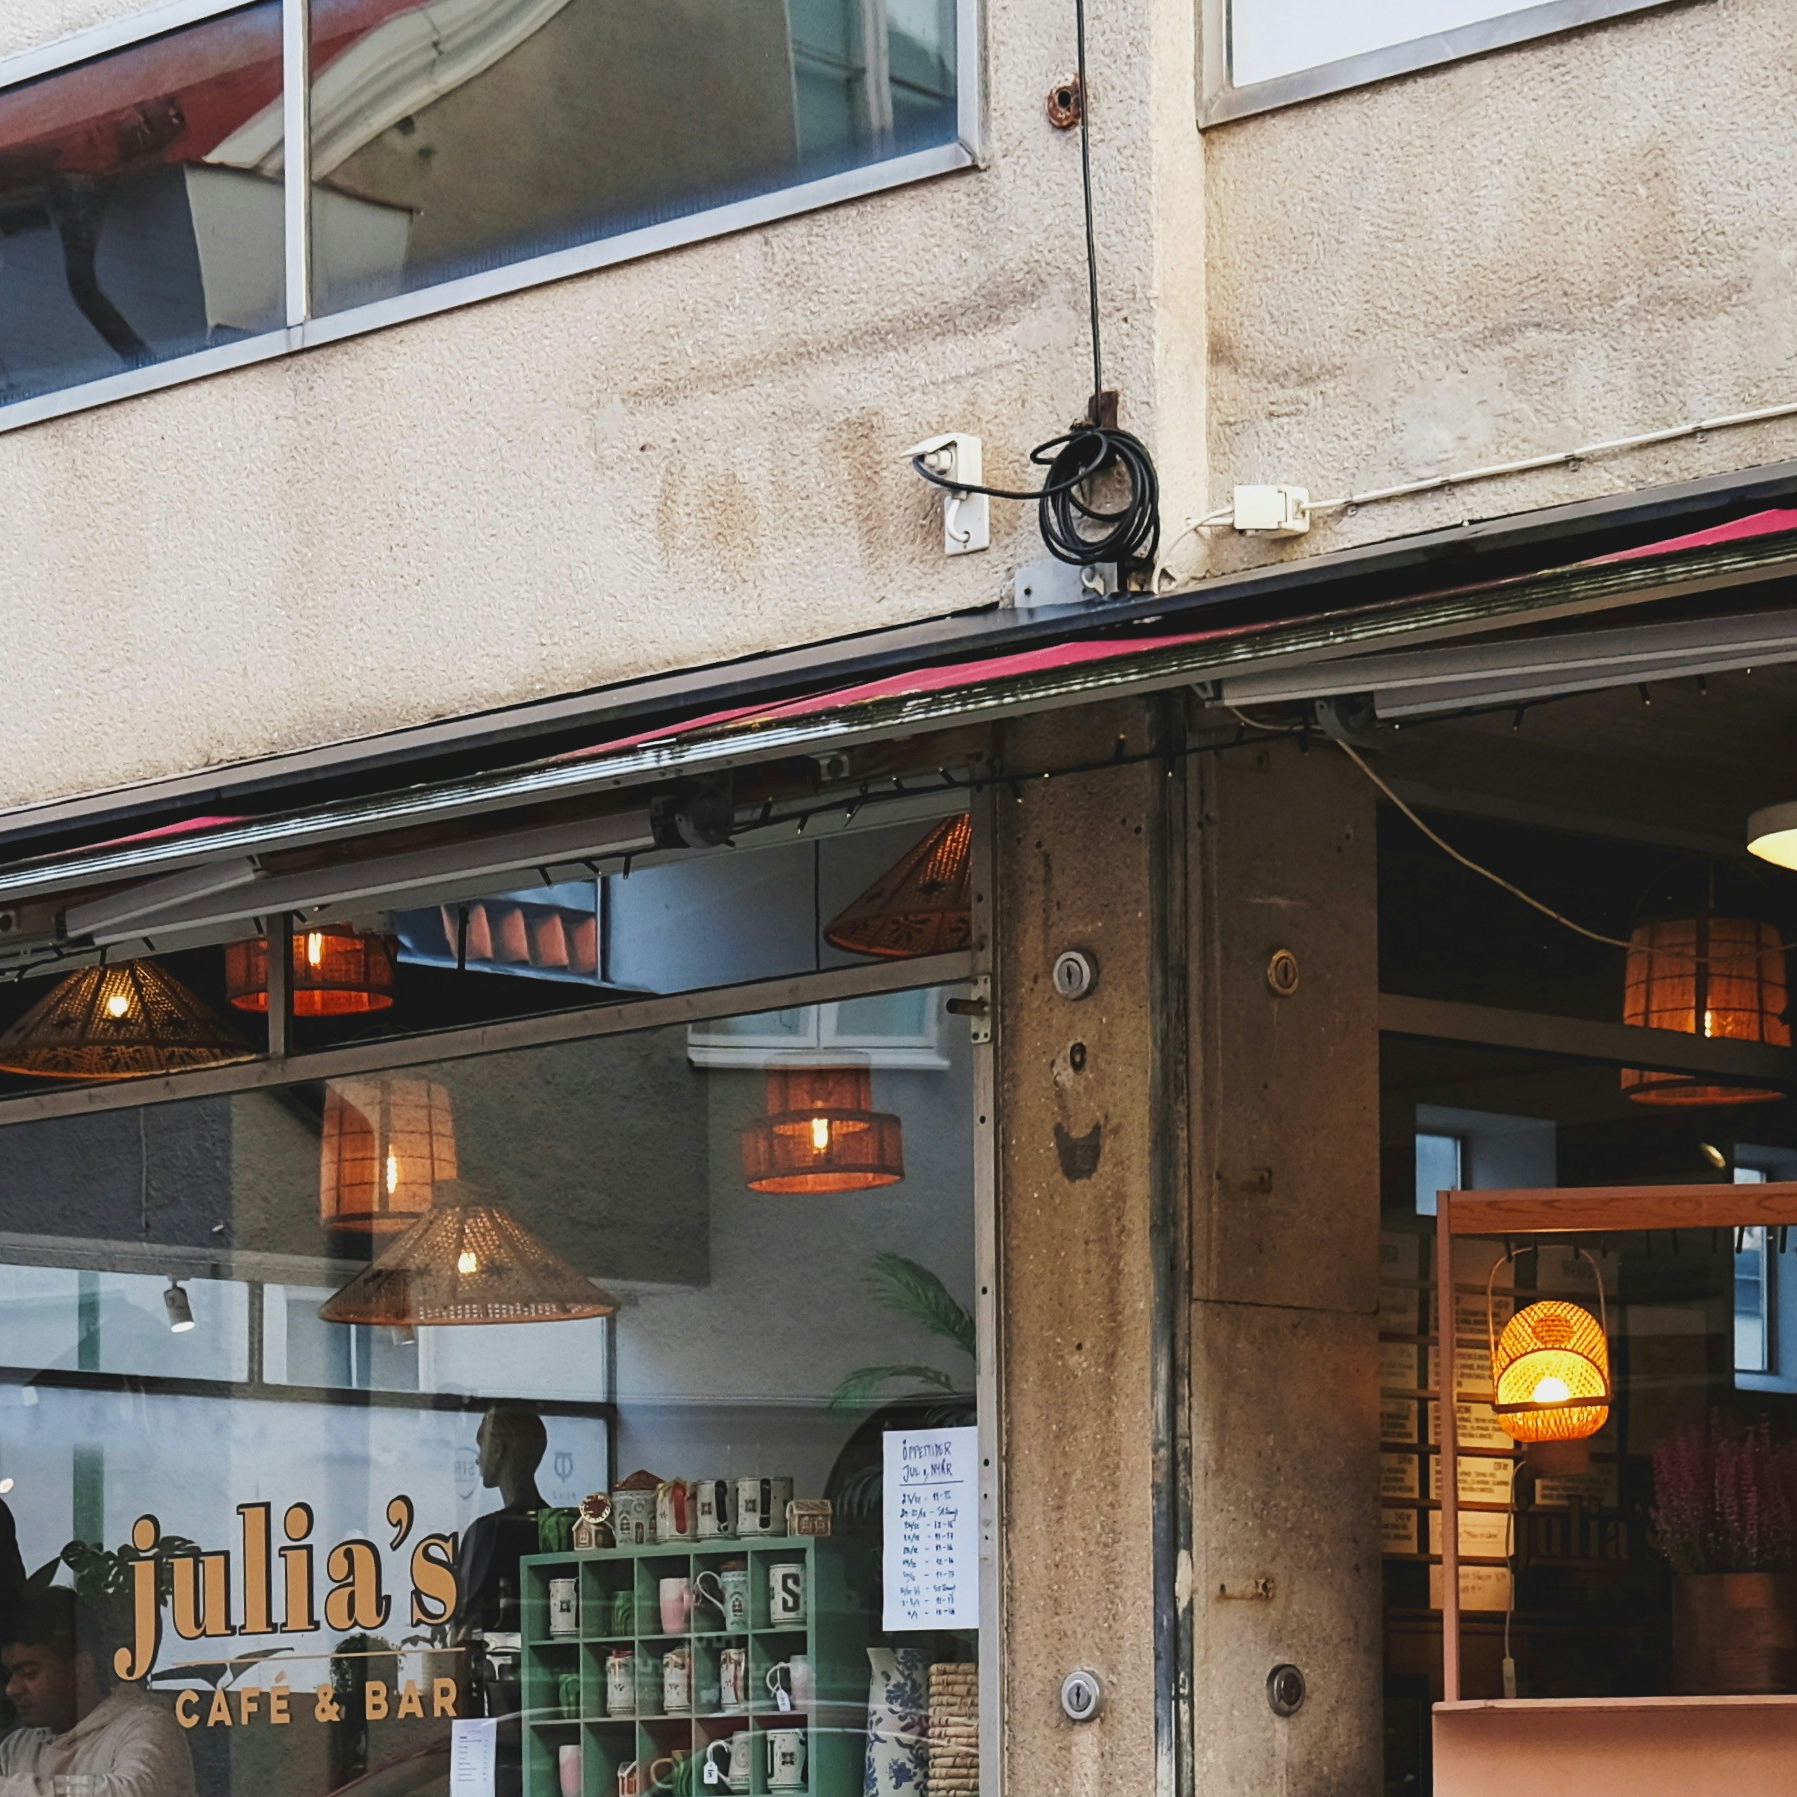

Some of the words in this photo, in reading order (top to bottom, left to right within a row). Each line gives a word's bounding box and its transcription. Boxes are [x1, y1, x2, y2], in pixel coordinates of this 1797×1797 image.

[114, 1494, 458, 1681] julia's
[175, 1670, 292, 1729] CAFÉ
[314, 1682, 341, 1723] &
[365, 1677, 459, 1721] BAR
